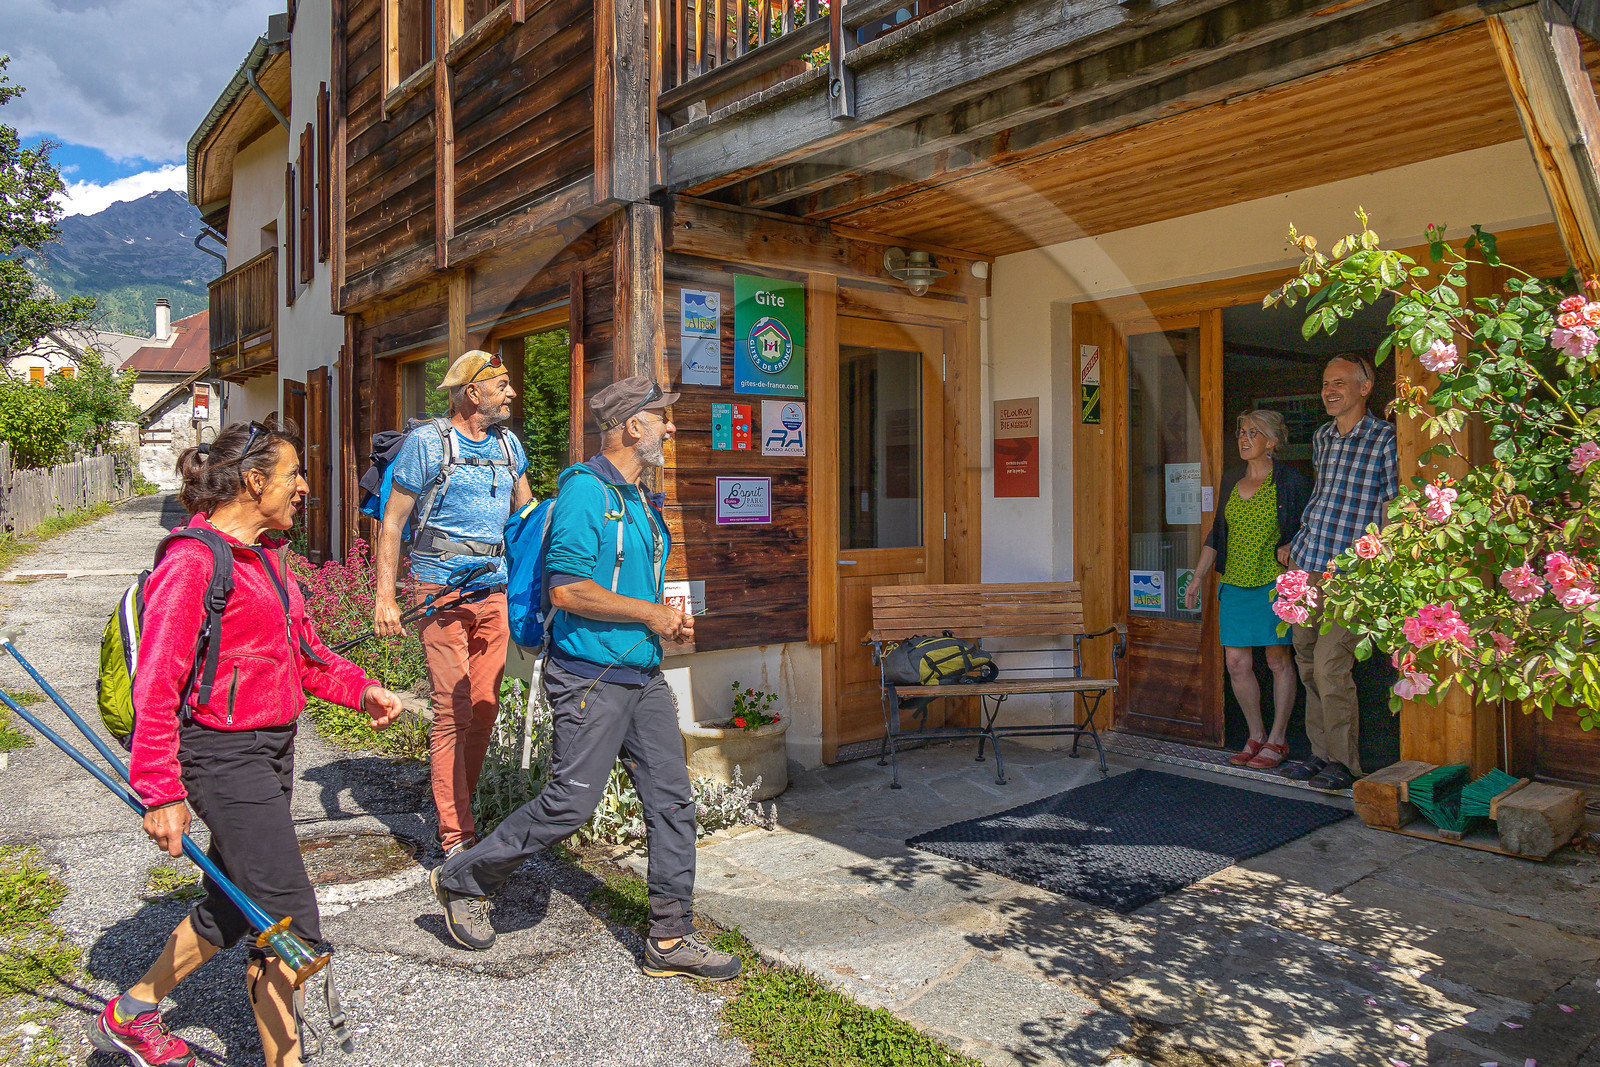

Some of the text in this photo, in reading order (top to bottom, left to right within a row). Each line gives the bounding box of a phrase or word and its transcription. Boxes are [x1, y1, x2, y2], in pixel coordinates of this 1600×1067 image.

[755, 290, 785, 307] Gîte
[689, 315, 714, 332] Alpes
[762, 362, 772, 371] DE
[774, 342, 791, 371] FRANCE
[1004, 408, 1032, 417] FLOUROU
[728, 483, 764, 505] Esprit
[1137, 593, 1159, 607] Alpes
